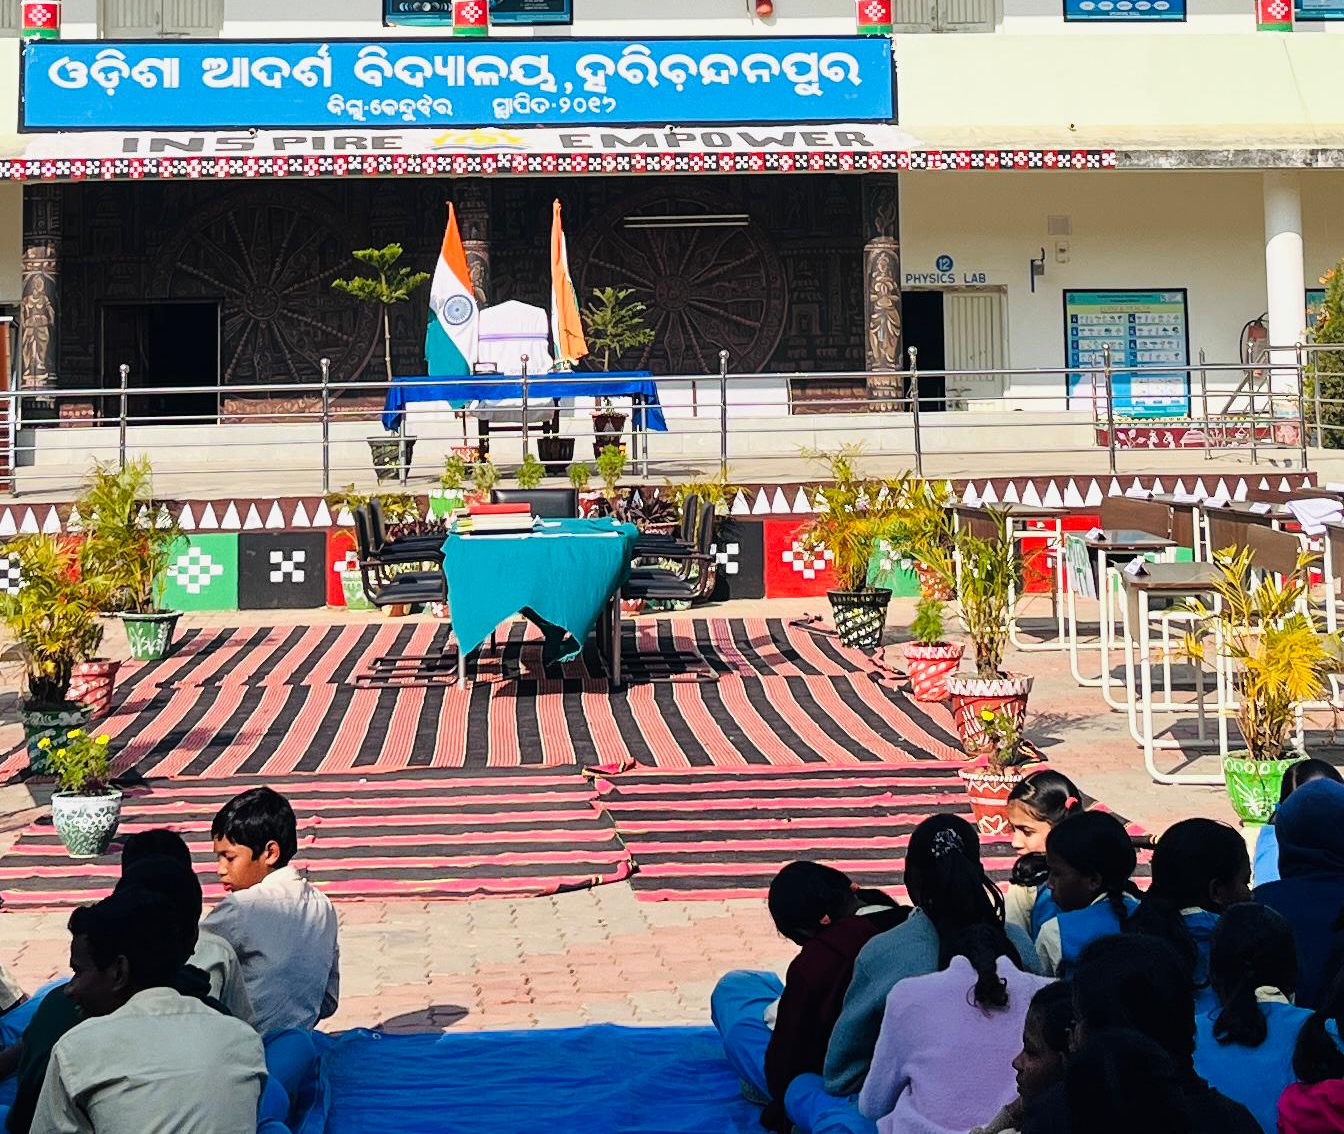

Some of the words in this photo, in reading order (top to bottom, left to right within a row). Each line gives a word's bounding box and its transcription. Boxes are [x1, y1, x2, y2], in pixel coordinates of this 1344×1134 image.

[47, 48, 180, 96] ଓଡ଼ିଶା
[201, 43, 332, 89] ଆଦର୍ଶ
[121, 135, 404, 153] INSPIRE
[558, 130, 876, 150] EMPOWER
[938, 257, 951, 271] 12
[905, 273, 956, 284] PHYSICS
[963, 272, 987, 284] LAB
